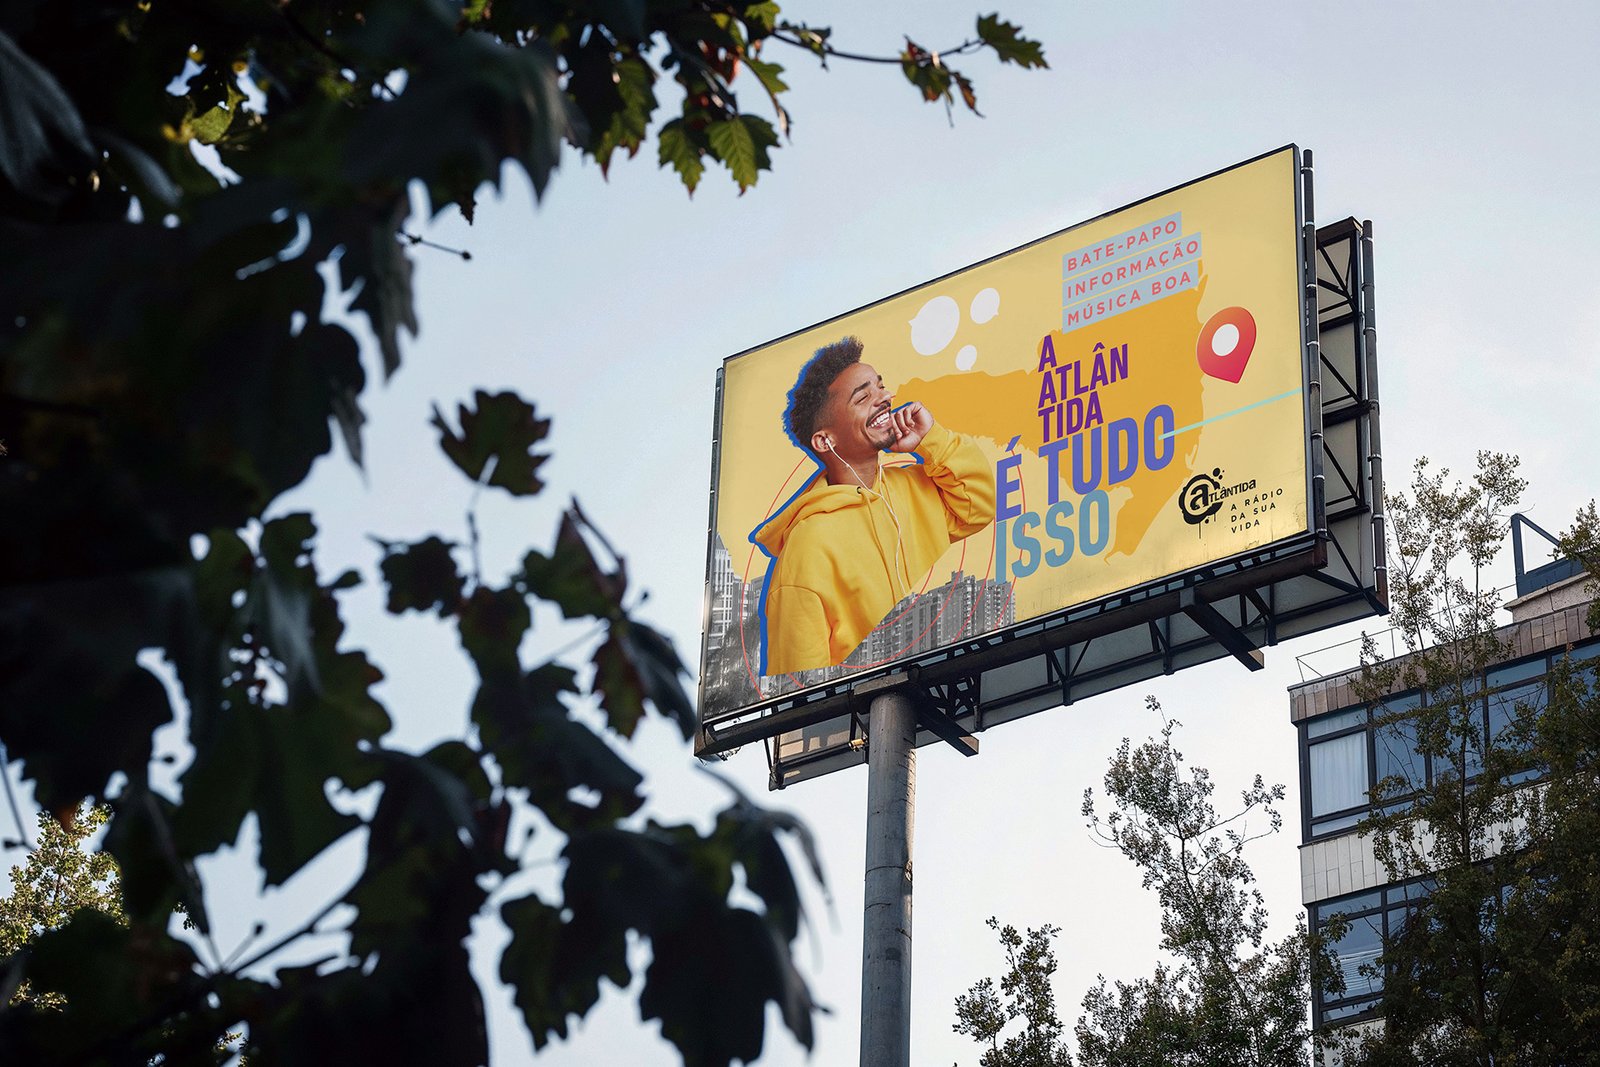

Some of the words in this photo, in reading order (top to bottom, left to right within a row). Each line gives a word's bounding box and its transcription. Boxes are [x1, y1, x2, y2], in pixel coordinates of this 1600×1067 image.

[1067, 220, 1177, 272] BATE-PAPO
[1067, 240, 1199, 299] INFORMAÇÃO
[1067, 289, 1141, 326] MÚSICA
[1151, 271, 1191, 296] BOA
[1038, 334, 1058, 373] A
[1038, 341, 1129, 409] ATLÂN
[1038, 390, 1104, 443] TIDA
[996, 434, 1022, 523] É
[1038, 404, 1175, 506] TUDO
[1230, 503, 1237, 511] A
[1244, 488, 1283, 507] RÁDIO
[1230, 512, 1246, 523] DA
[1253, 502, 1276, 516] SUA
[995, 489, 1110, 585] ISSO
[1231, 519, 1260, 534] VIDA
